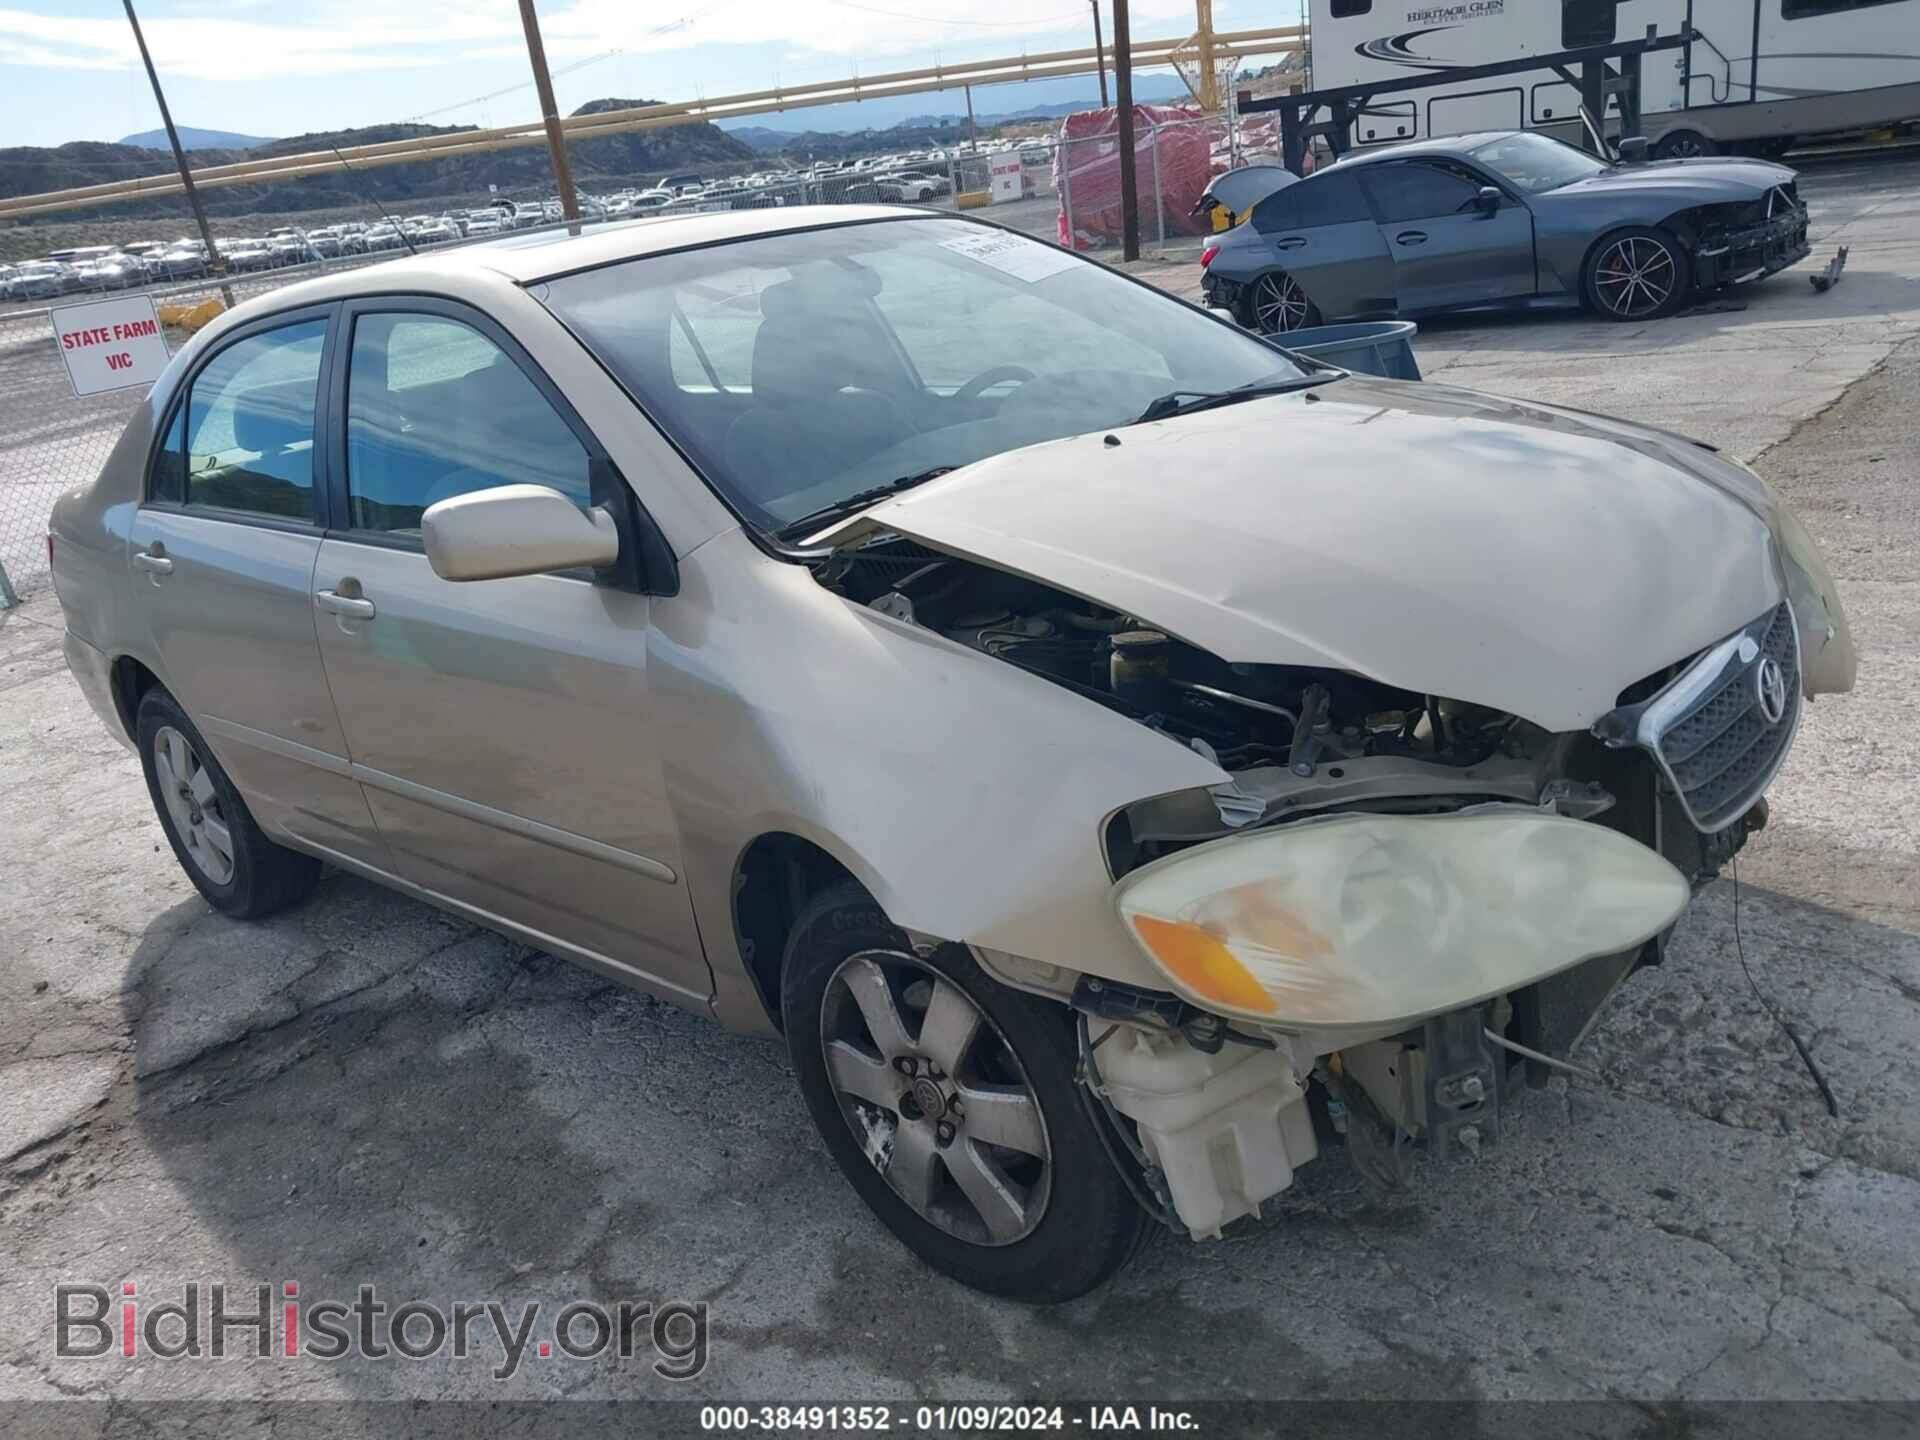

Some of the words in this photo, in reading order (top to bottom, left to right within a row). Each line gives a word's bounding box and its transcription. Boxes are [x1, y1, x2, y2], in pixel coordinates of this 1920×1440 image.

[1407, 5, 1466, 22] HERITAGE
[1469, 0, 1504, 12] GLEN
[62, 327, 111, 350] STATE
[113, 319, 158, 341] FARM
[105, 352, 133, 371] VIC
